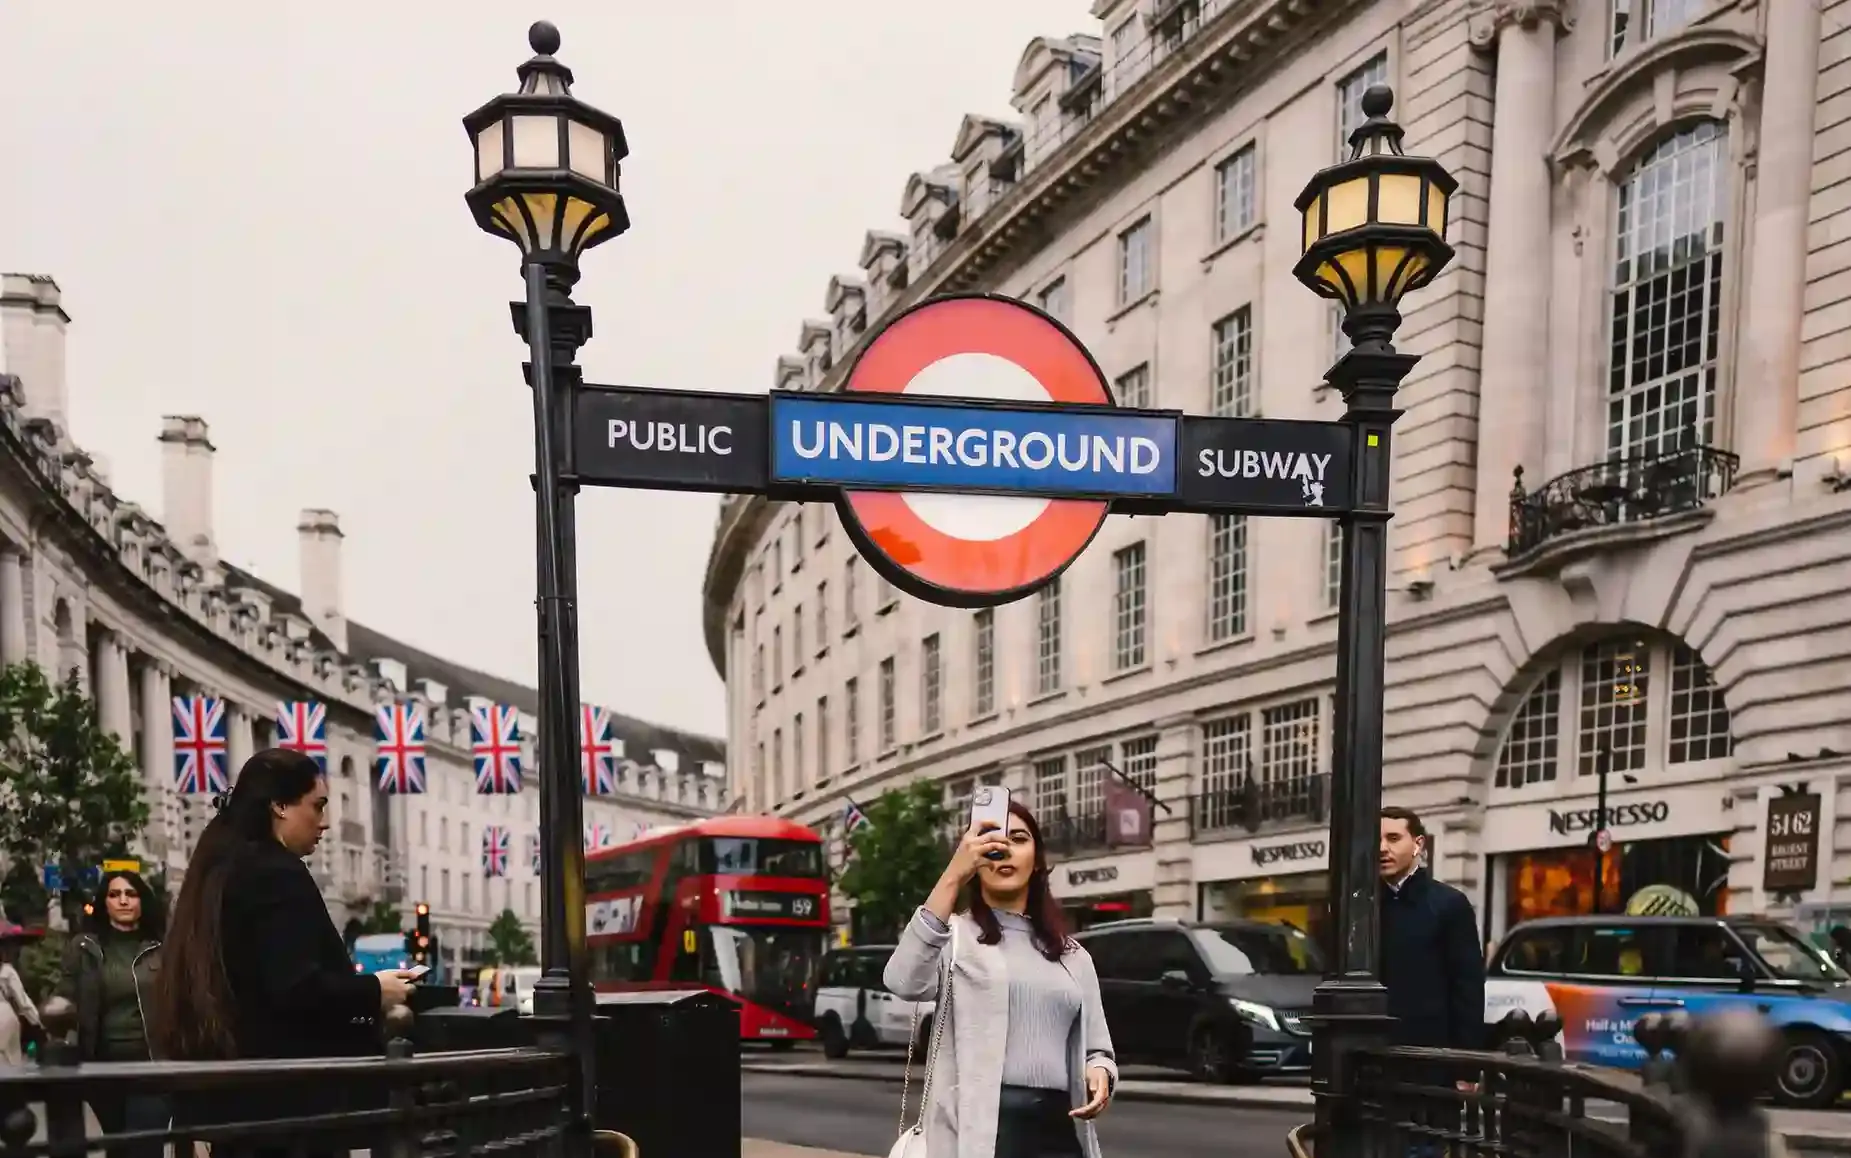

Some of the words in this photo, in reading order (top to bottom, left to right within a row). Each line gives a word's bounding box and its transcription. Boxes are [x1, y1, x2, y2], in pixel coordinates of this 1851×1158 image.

[608, 419, 732, 455] PUBLIC
[792, 419, 1161, 475] UNDERGROUND
[1199, 448, 1332, 481] SUBWAY
[1549, 801, 1669, 836] NESPRESSO
[1250, 840, 1325, 868] NESPRESSO
[1067, 866, 1119, 886] NESPRESSO
